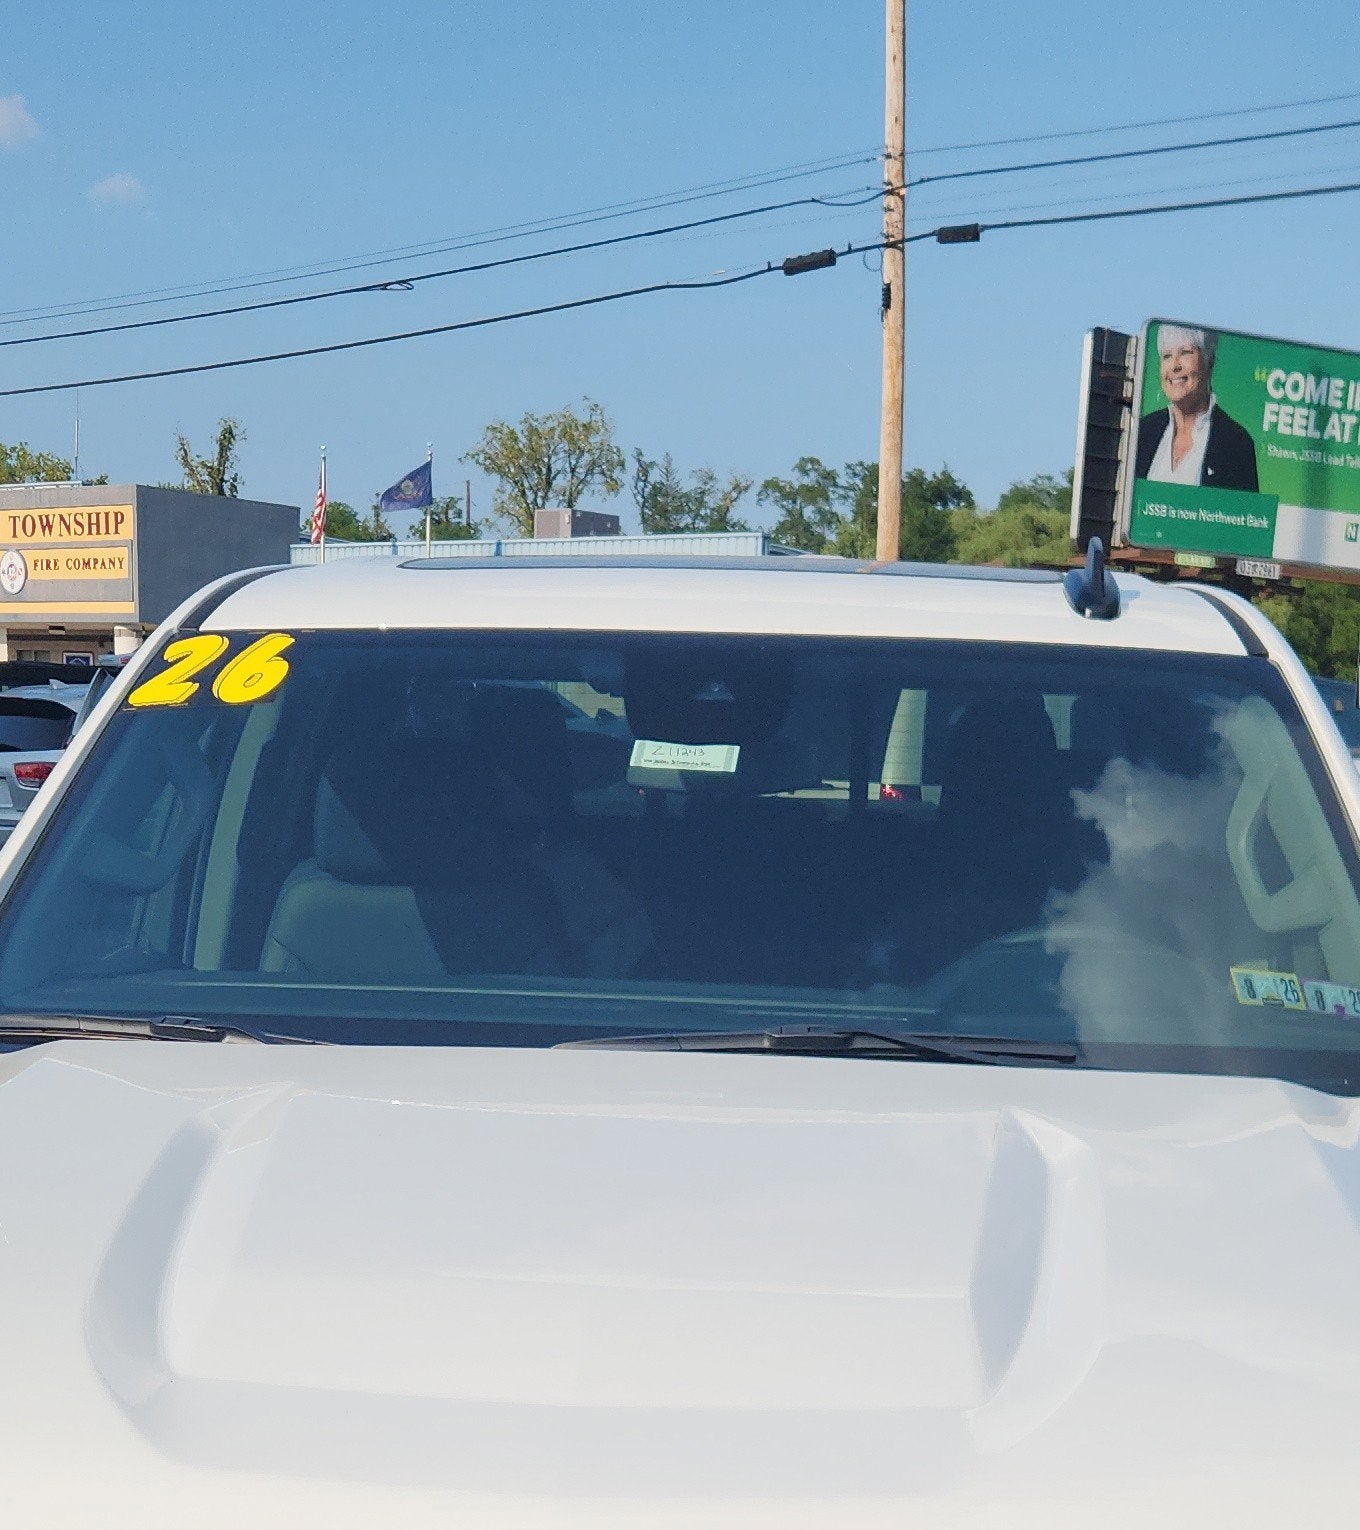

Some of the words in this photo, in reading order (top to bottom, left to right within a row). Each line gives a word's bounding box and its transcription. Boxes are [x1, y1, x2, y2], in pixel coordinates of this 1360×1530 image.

[1262, 401, 1321, 439] FEEL
[1323, 412, 1358, 443] AT
[8, 511, 125, 539] TOWNSHIP
[1143, 502, 1167, 518] JSSB
[1168, 504, 1176, 518] is
[1177, 509, 1199, 521] now
[1199, 508, 1246, 526] Northwest
[1246, 513, 1269, 529] Bank
[33, 558, 60, 571] FIRE
[66, 556, 125, 571] COMPANY
[128, 632, 296, 707] 26
